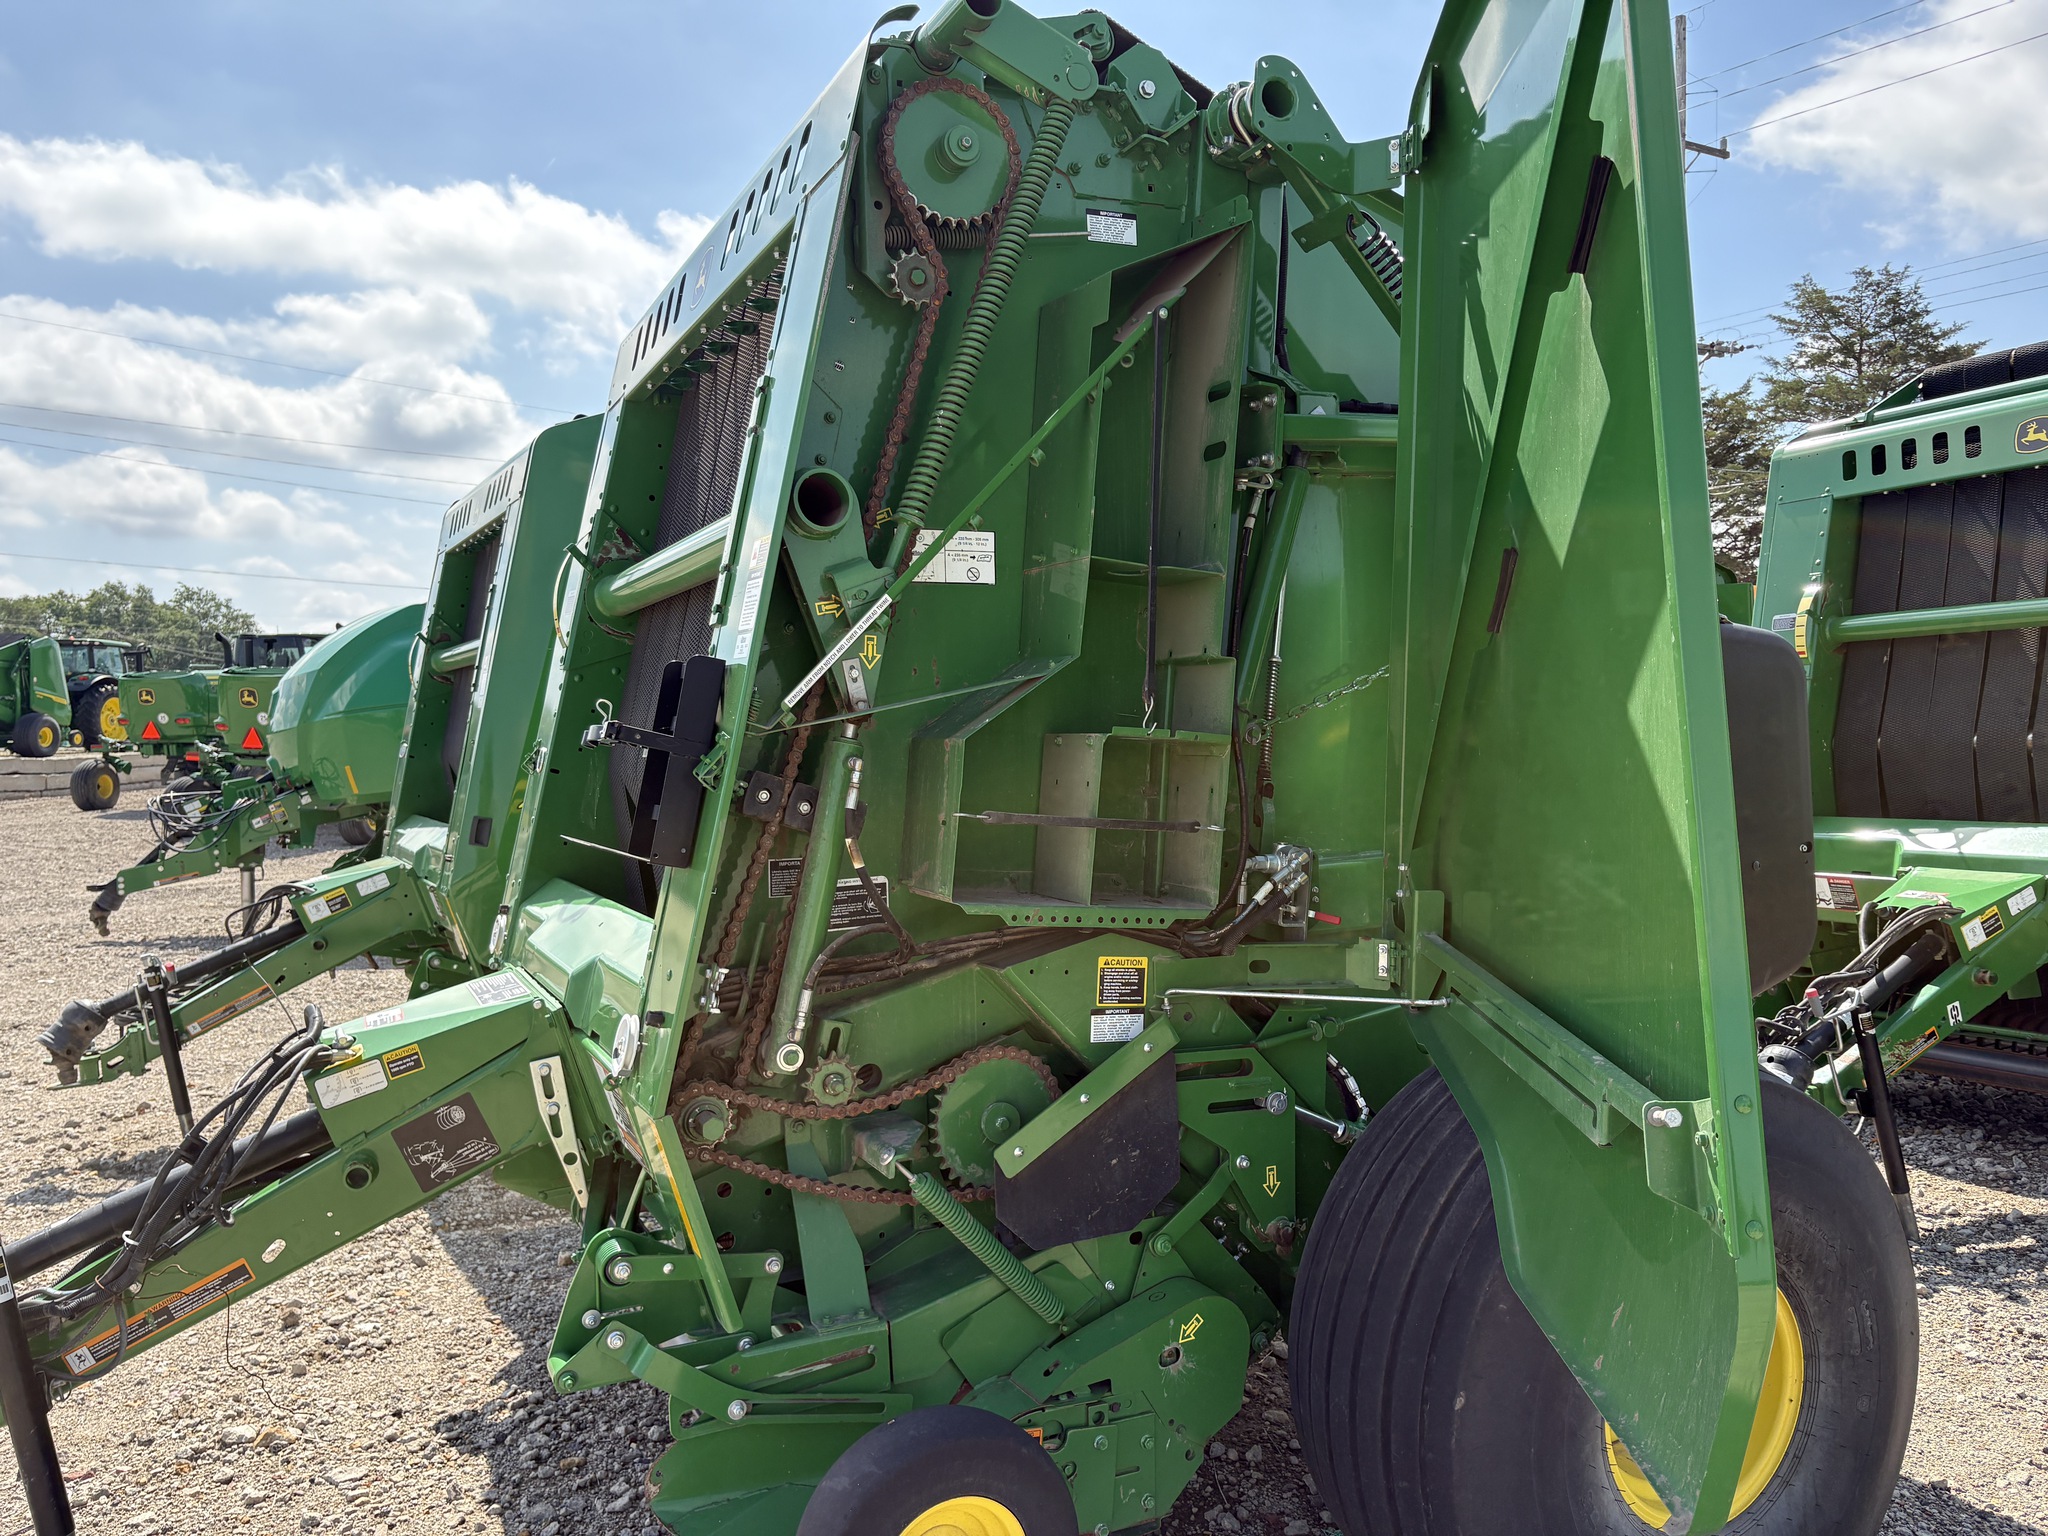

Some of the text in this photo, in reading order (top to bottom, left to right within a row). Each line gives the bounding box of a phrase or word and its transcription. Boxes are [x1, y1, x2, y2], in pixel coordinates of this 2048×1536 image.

[788, 688, 805, 705] REMOVE
[804, 676, 813, 688] ARM
[812, 665, 824, 680] FROM
[824, 652, 837, 667] NOTCH
[836, 644, 846, 655] AND
[844, 630, 858, 645] LOWER
[862, 609, 878, 626] THREAD
[877, 597, 890, 611] TWINE
[391, 1046, 417, 1059] CAUTION
